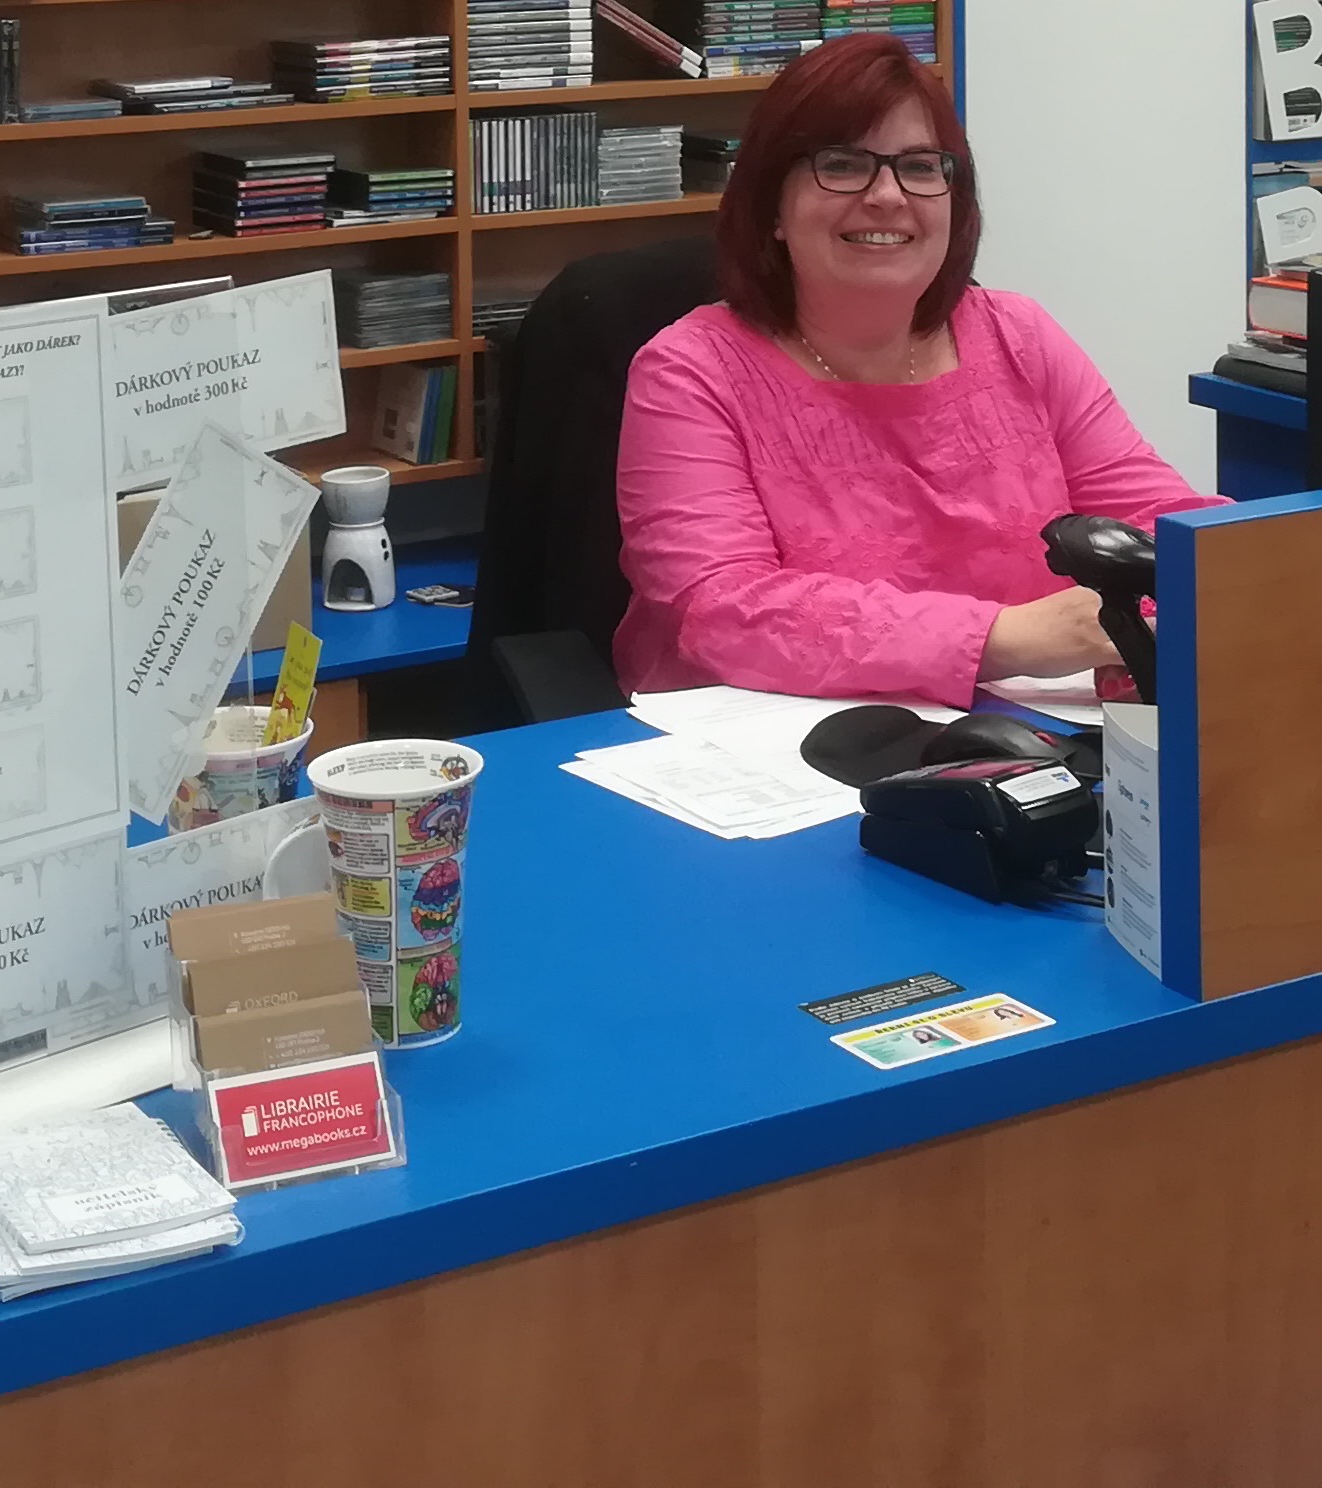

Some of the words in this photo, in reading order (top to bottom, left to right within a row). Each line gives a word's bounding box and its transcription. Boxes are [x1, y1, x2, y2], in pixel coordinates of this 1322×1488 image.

[2, 341, 33, 360] JAKO
[36, 334, 81, 351] DÁREK?
[115, 361, 194, 398] DÁRKOVÝ
[197, 349, 262, 378] POUKAZ
[133, 406, 142, 416] v
[145, 388, 202, 415] hodnotě
[204, 380, 230, 400] 300
[231, 376, 249, 394] Kč
[126, 605, 180, 697] DÁRKOVÝ
[172, 528, 217, 606] POUKAZ
[154, 677, 166, 689] v
[162, 612, 201, 677] hodnotě
[193, 580, 214, 611] 100
[206, 557, 227, 586] Kč
[129, 889, 204, 931] DÁRKOVÝ
[207, 871, 264, 906] POUKA
[9, 947, 30, 967] Kč
[142, 938, 153, 950] v
[244, 991, 299, 1011] OXFORD
[260, 1090, 341, 1119] LIBRAIRIE
[263, 1103, 364, 1134] FRANCOPHONE
[246, 1125, 368, 1157] www.megabooks.cz
